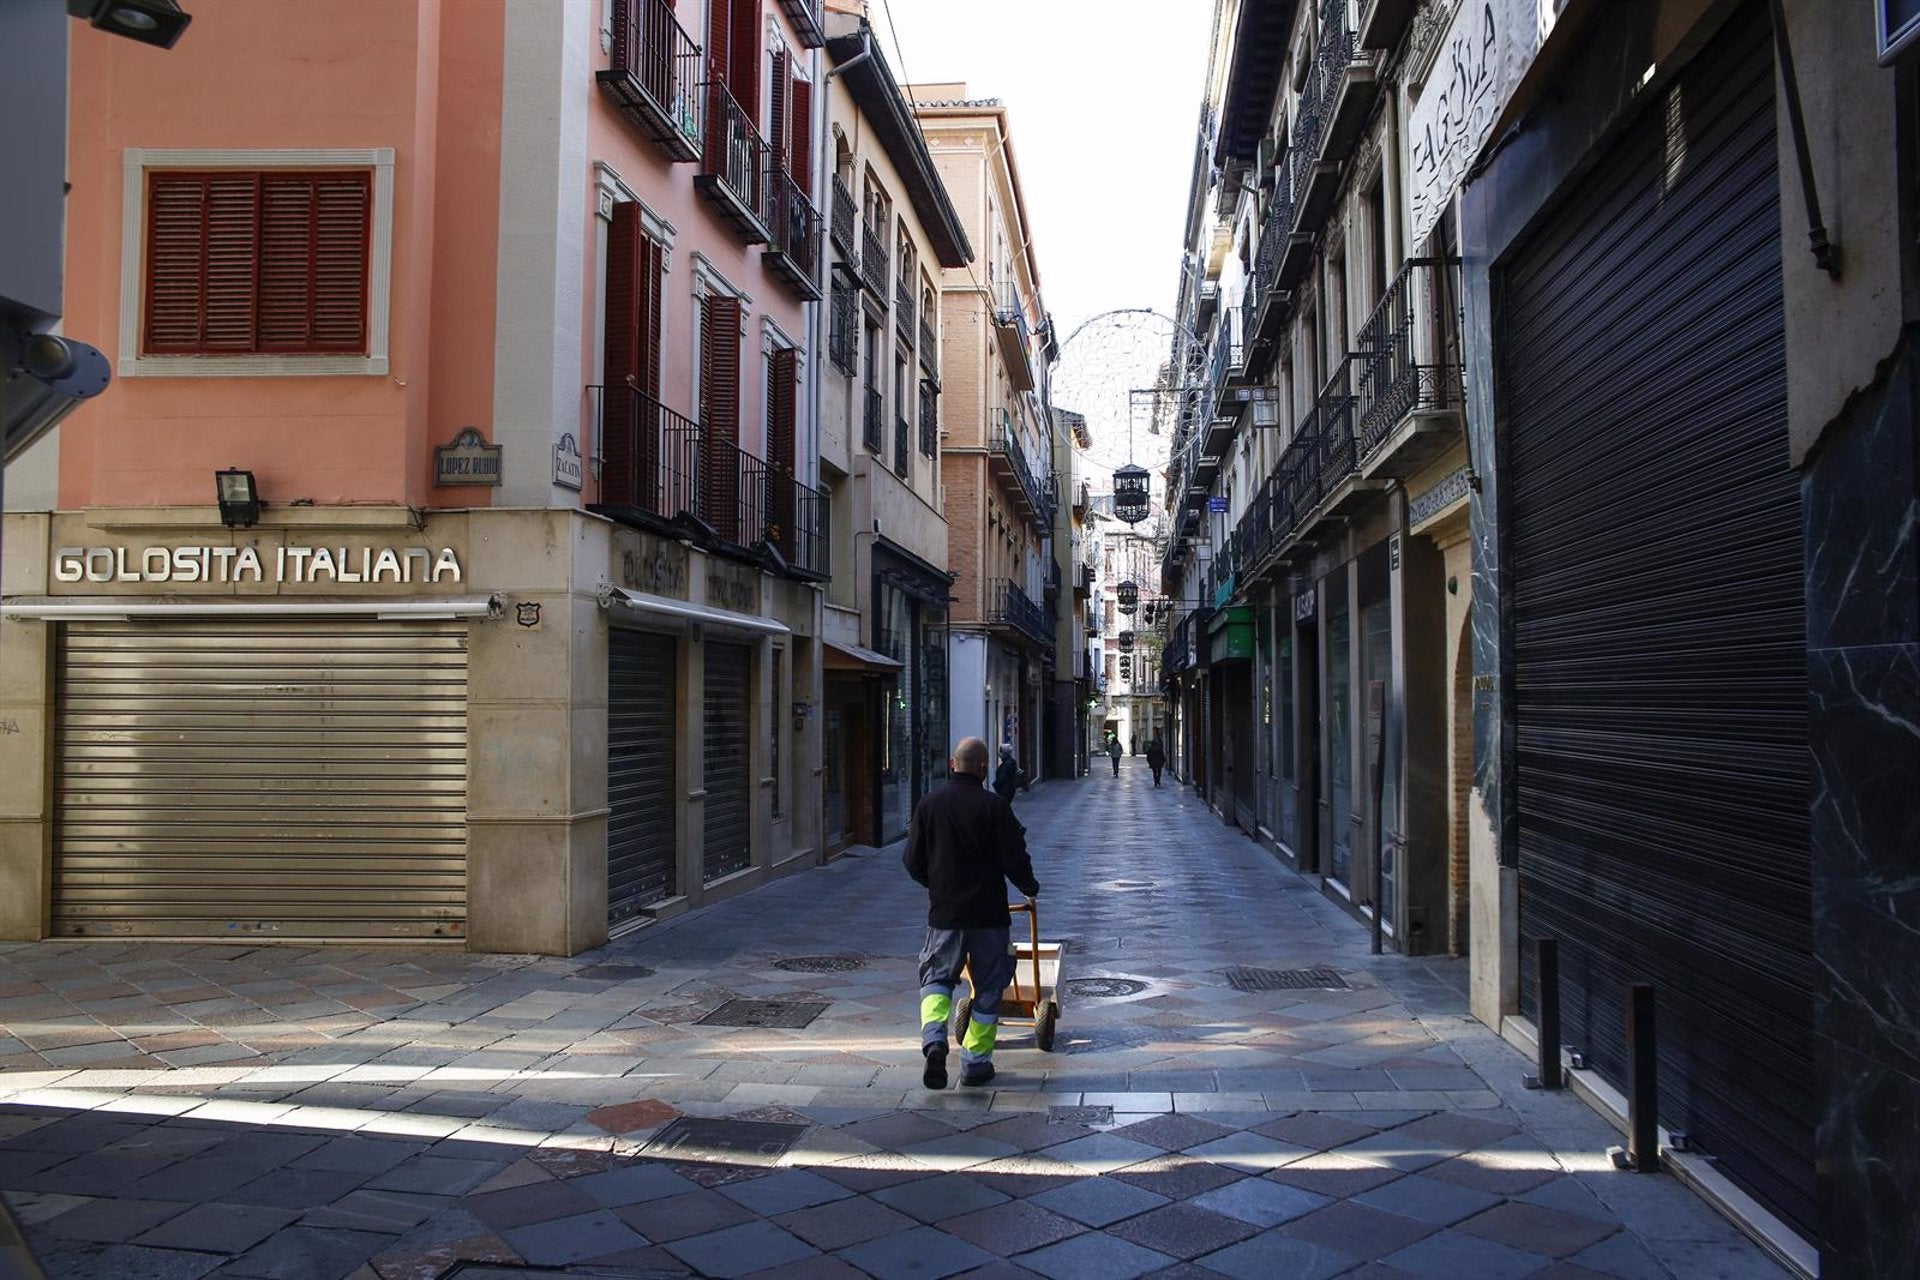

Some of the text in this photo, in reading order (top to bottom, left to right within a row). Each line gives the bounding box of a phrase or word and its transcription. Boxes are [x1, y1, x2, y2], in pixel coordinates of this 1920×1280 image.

[441, 457, 470, 475] LOPEZ
[55, 546, 461, 583] GOLOSITA ITALIANA
